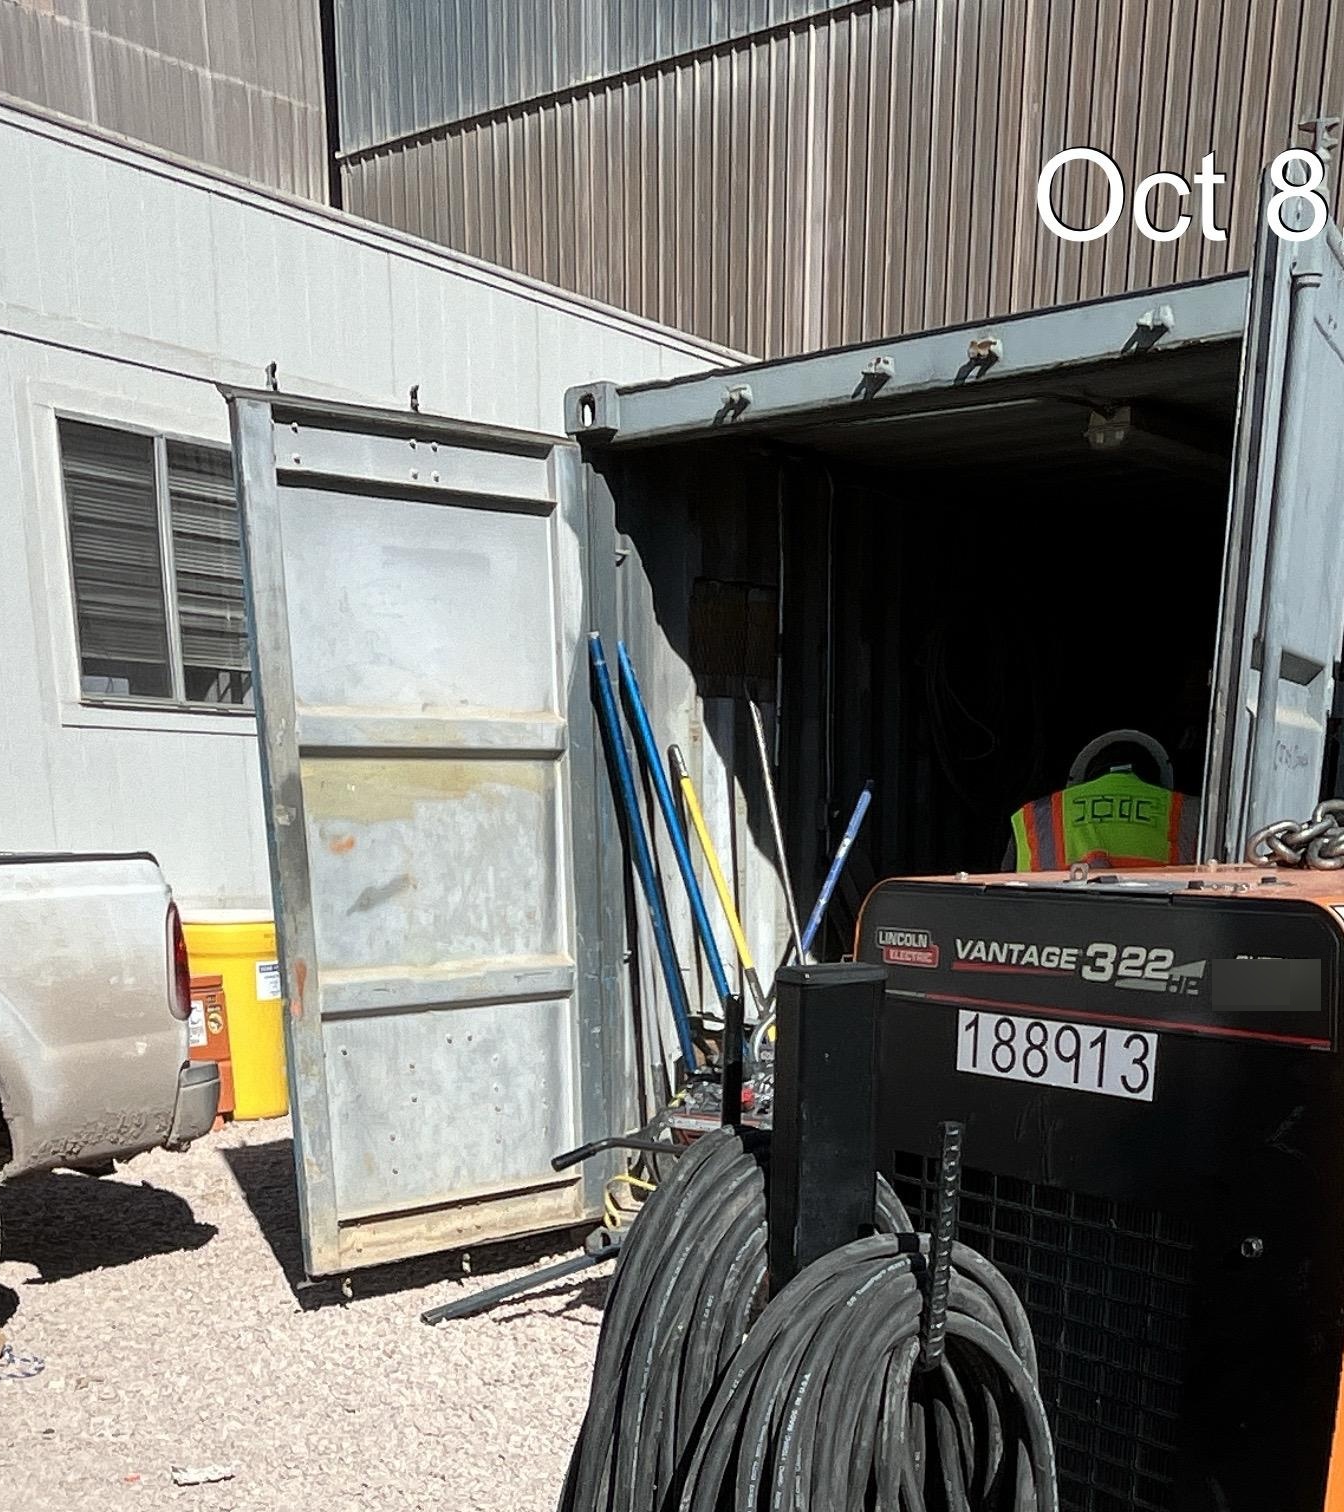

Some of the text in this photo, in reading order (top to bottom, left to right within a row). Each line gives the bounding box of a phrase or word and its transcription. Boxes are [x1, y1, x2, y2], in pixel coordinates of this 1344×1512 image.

[878, 930, 928, 948] LINCOLN
[889, 949, 933, 964] ELECTRIC
[955, 938, 1175, 982] VANTAGE 322
[963, 1012, 1152, 1095] 188913
